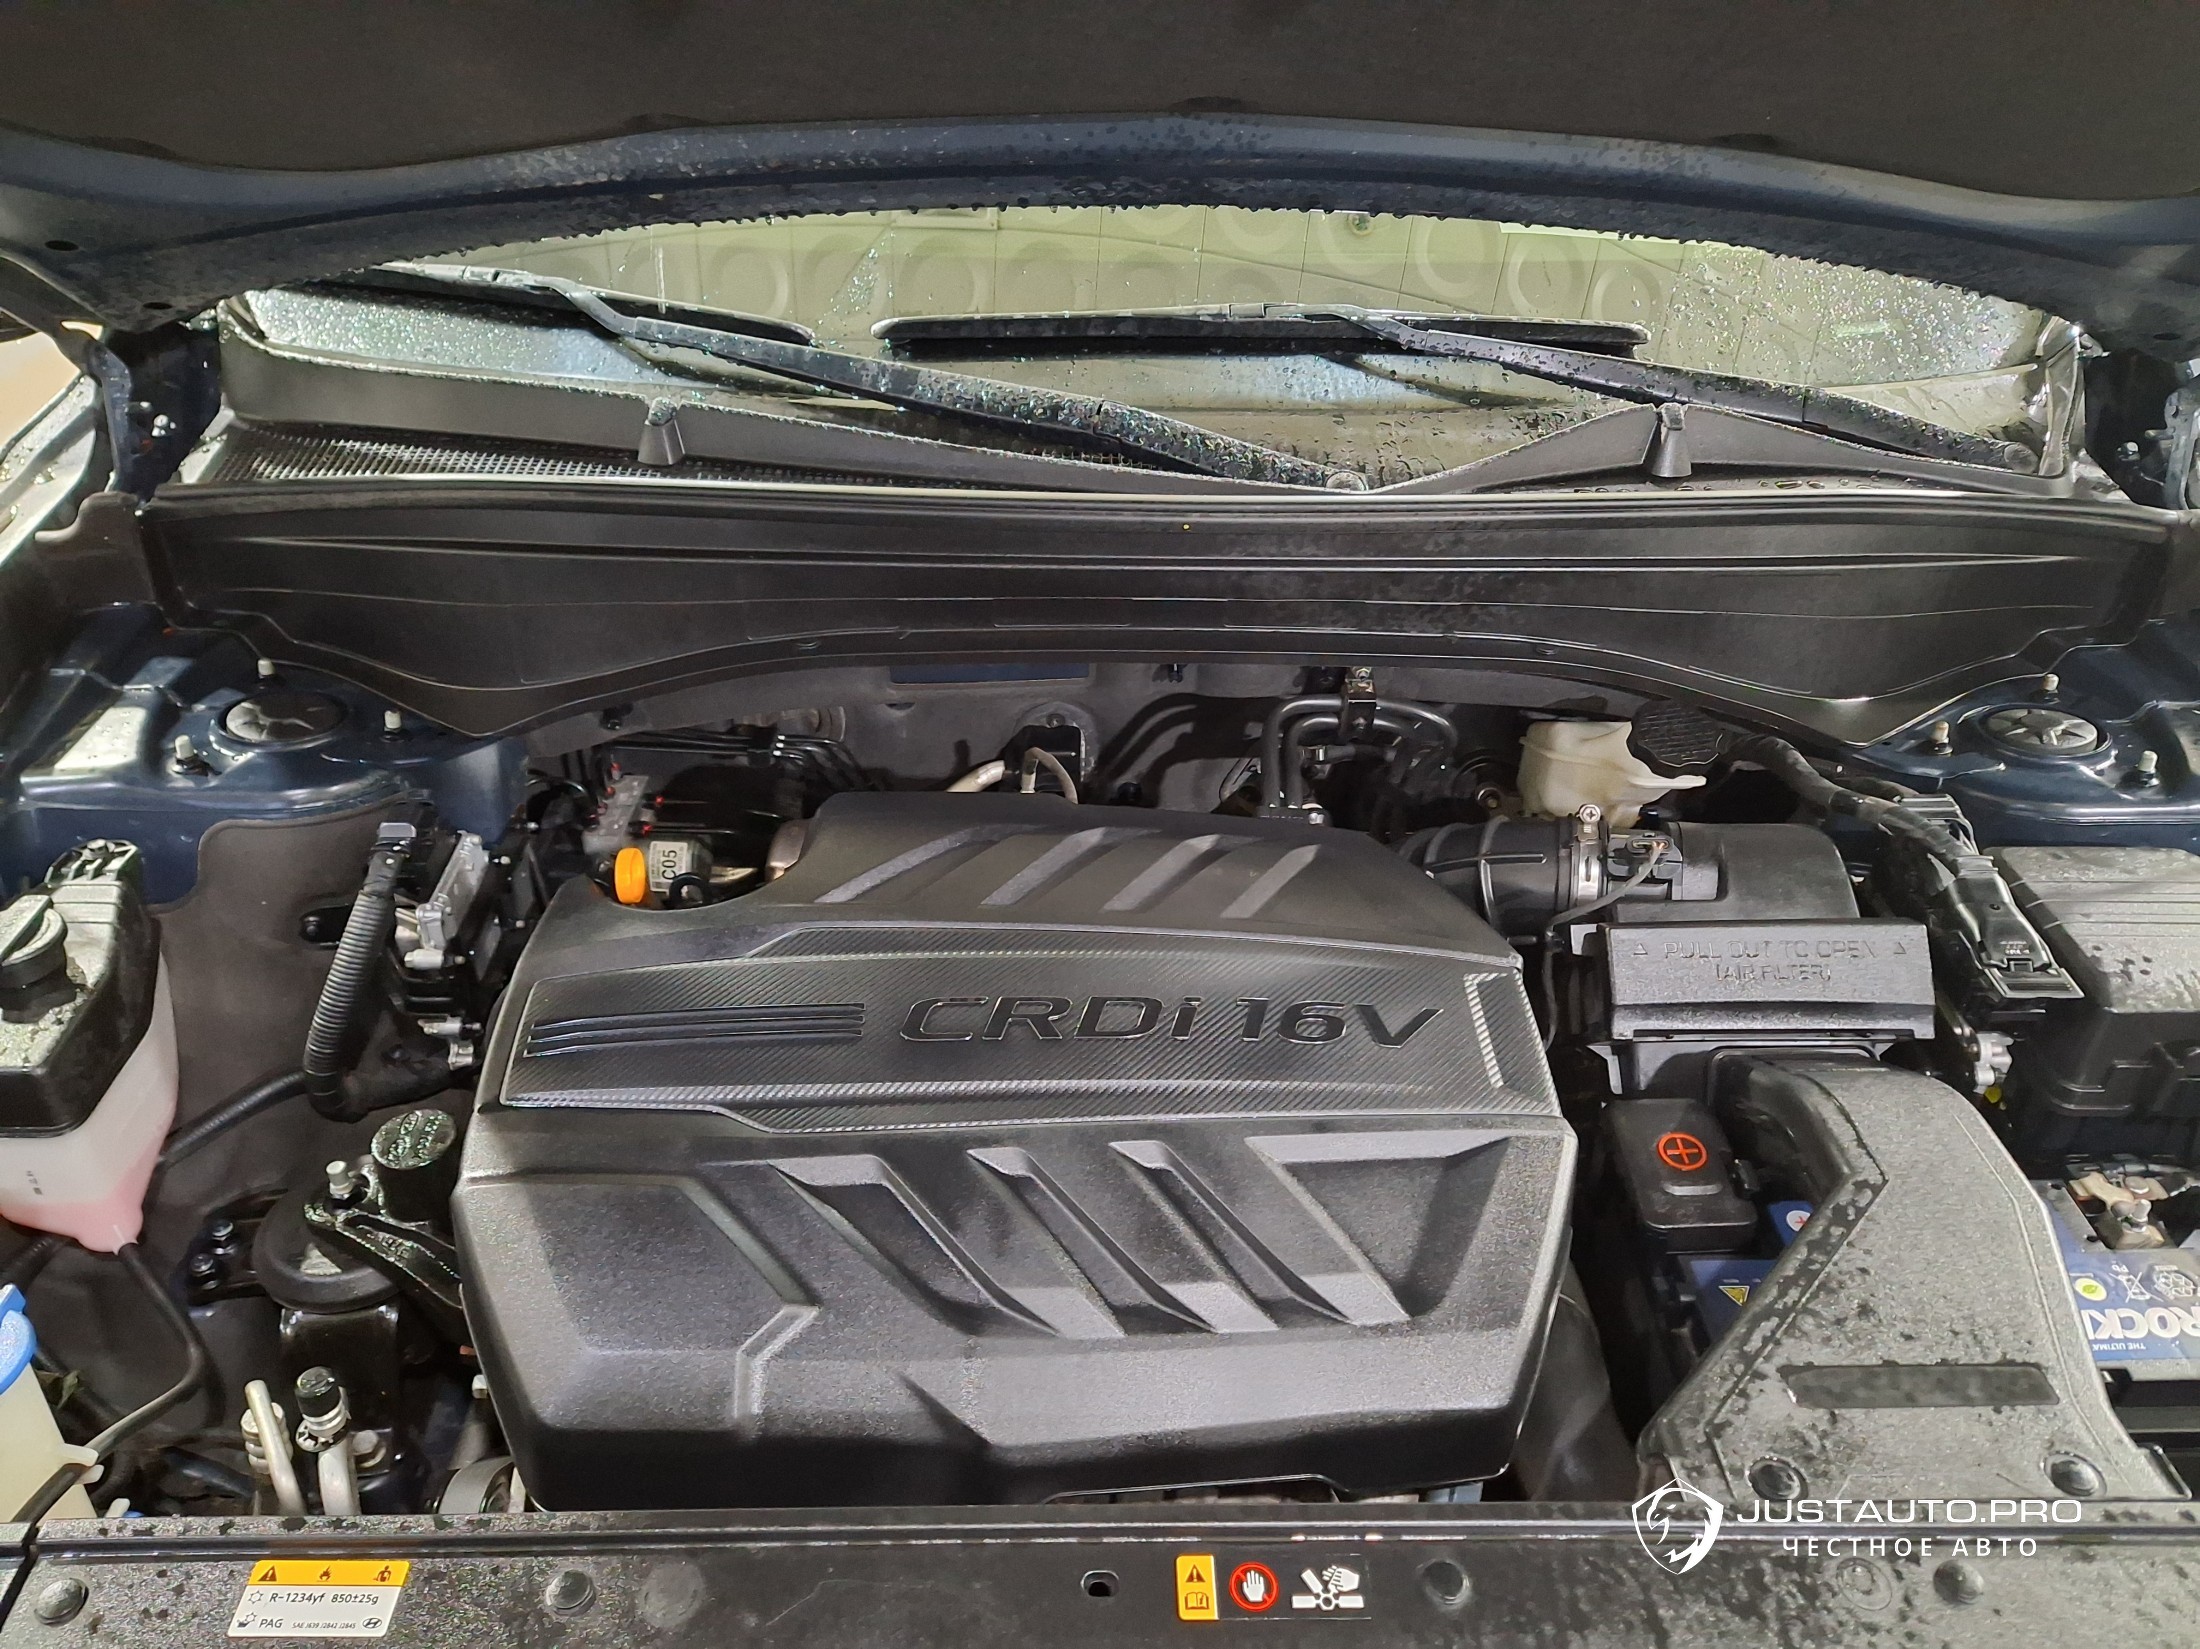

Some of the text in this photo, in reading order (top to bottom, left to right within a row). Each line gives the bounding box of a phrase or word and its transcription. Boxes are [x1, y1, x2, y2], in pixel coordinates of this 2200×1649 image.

[661, 850, 677, 880] C05
[1664, 941, 1721, 959] PULL
[1728, 940, 1771, 958] OUT
[900, 995, 1445, 1048] CRDi 16V
[2092, 1342, 2146, 1351] THE ULTIMA
[269, 1592, 379, 1605] R-1234yf 850±25g
[258, 1618, 284, 1629] PAG
